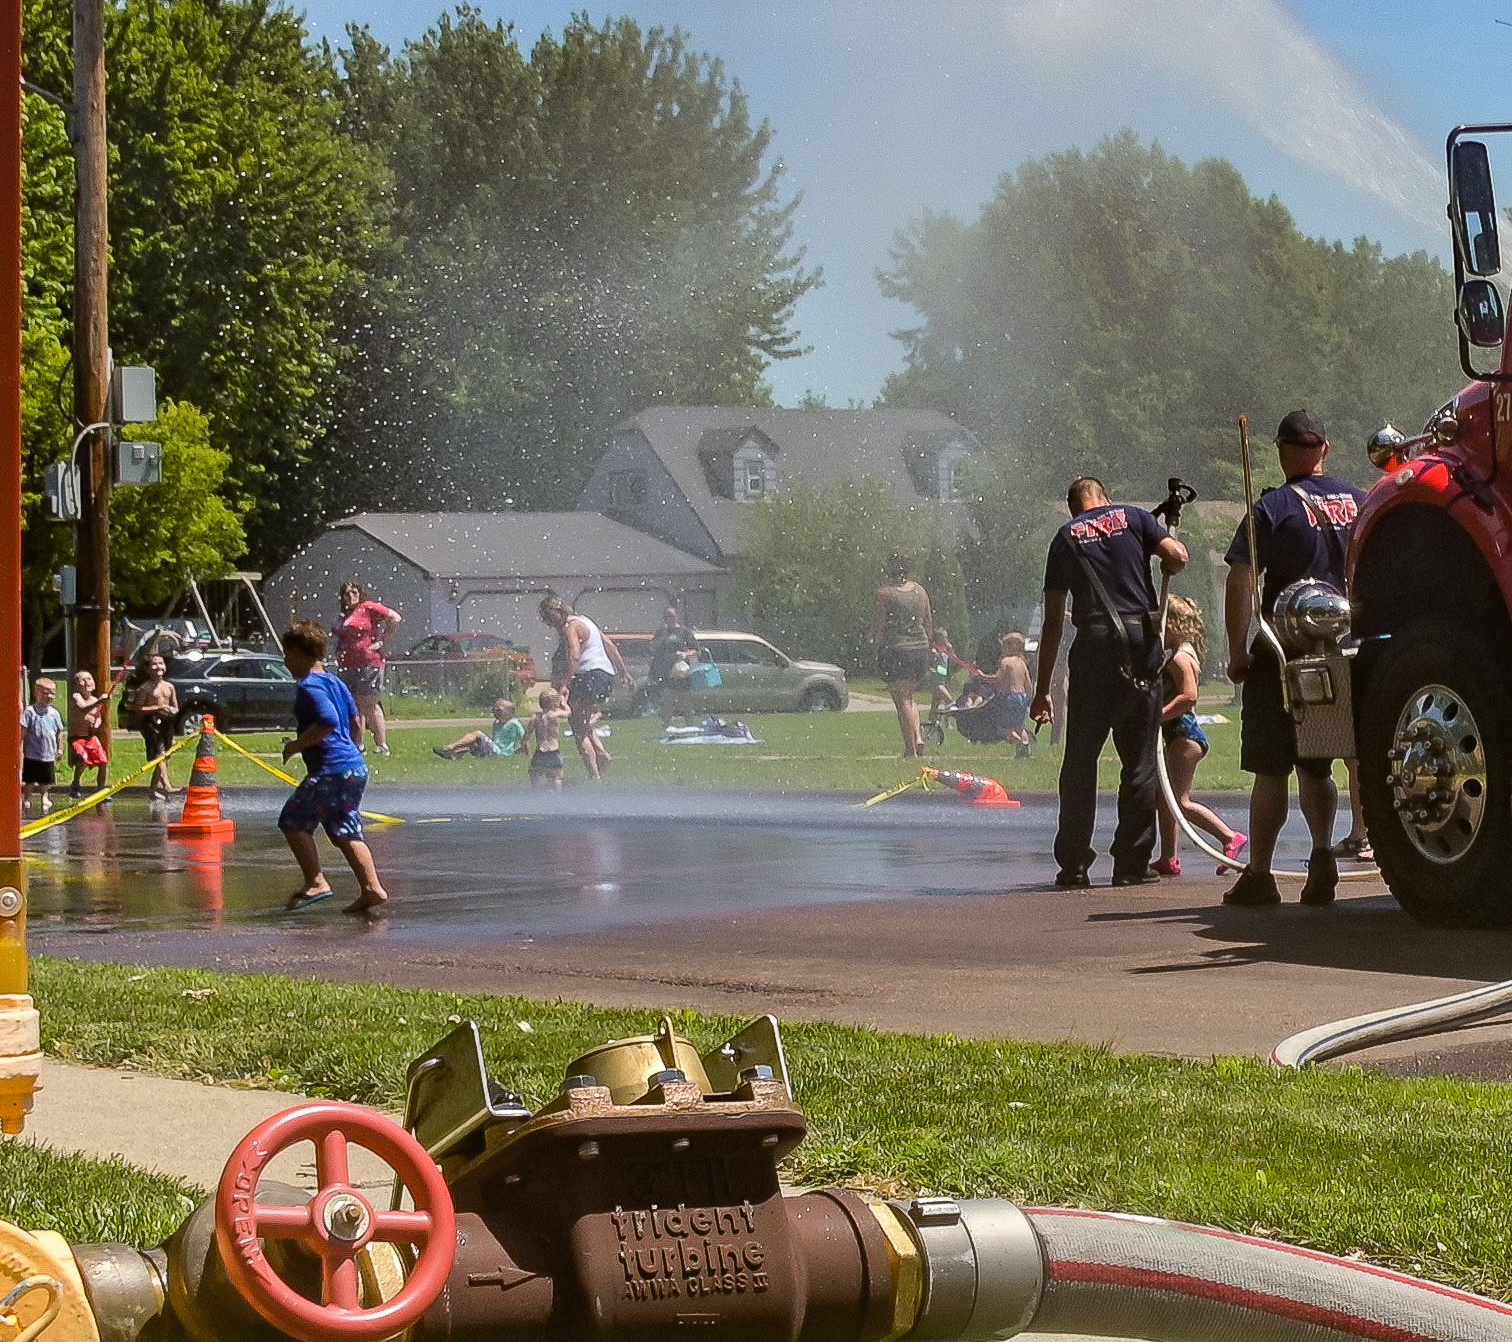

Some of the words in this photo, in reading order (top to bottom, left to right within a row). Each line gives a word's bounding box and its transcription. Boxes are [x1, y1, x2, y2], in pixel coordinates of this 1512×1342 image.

[1496, 393, 1511, 422] 27
[611, 1200, 756, 1241] trident
[617, 1239, 765, 1281] turbine
[622, 1278, 681, 1301] AWWA
[686, 1274, 749, 1297] CLASS
